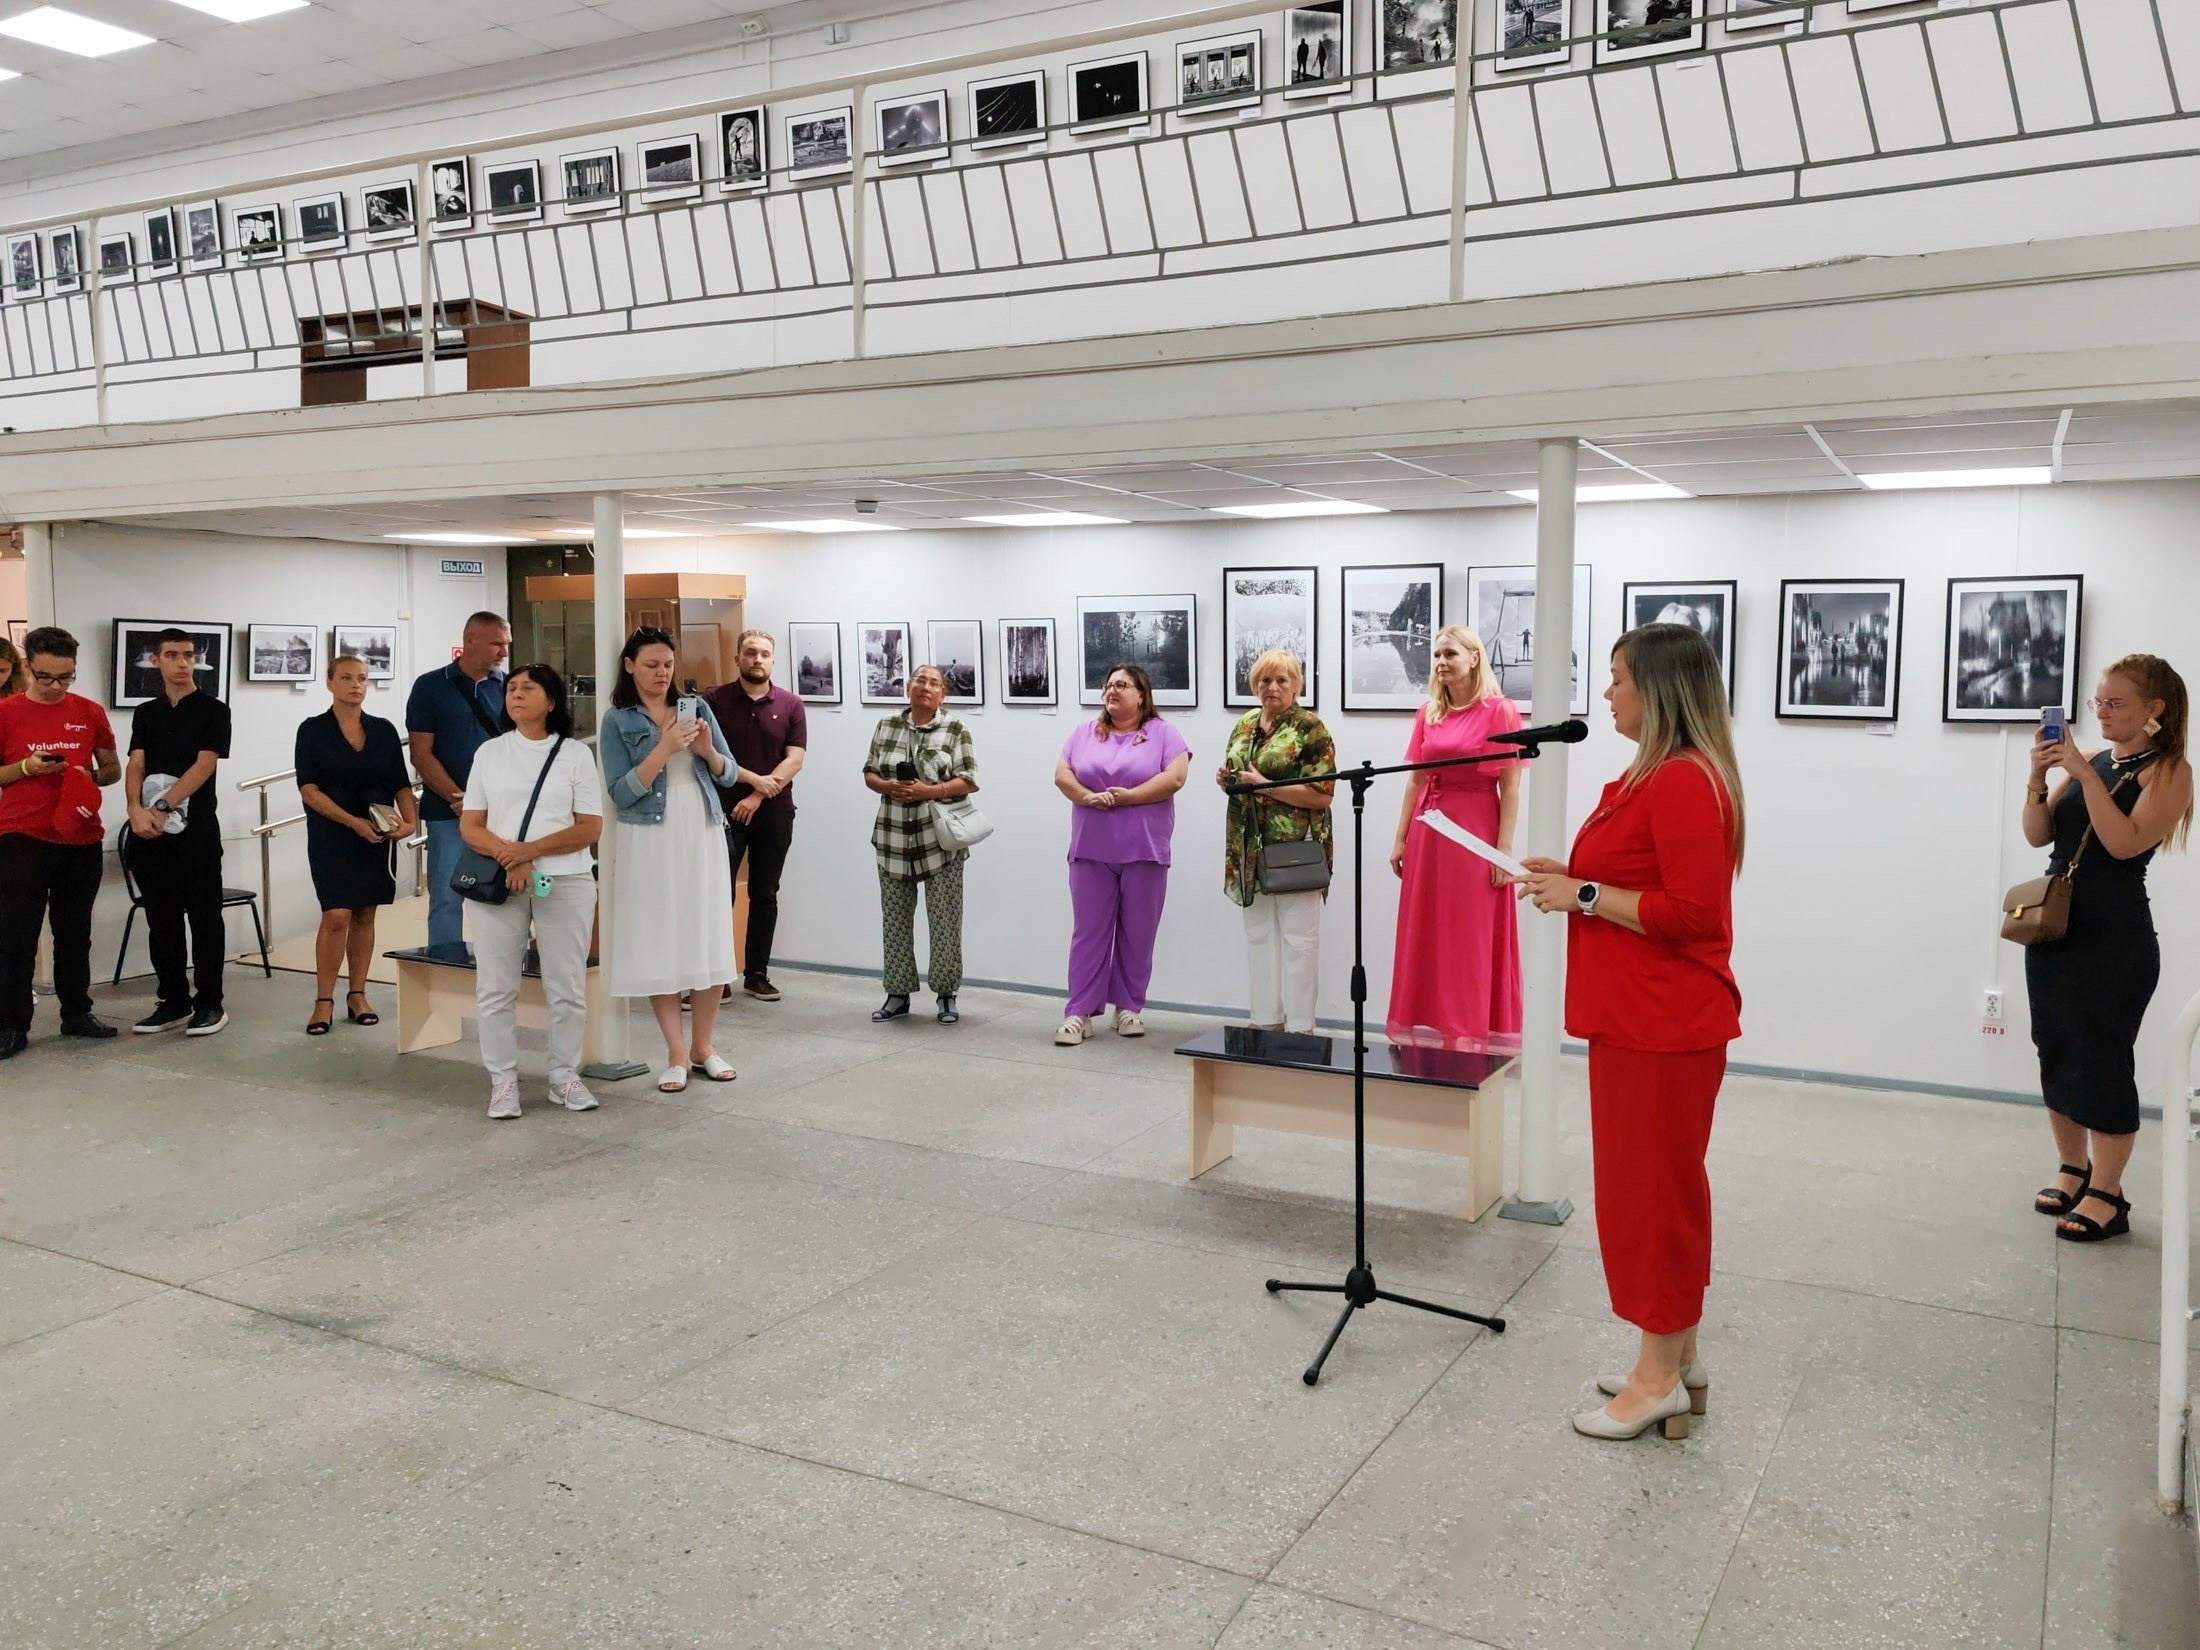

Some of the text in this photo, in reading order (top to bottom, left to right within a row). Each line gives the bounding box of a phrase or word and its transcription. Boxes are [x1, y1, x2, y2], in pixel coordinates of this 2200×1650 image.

[443, 562, 480, 572] ВЫХОД
[27, 741, 81, 751] Volunteer
[1982, 1026, 1997, 1034] 220
